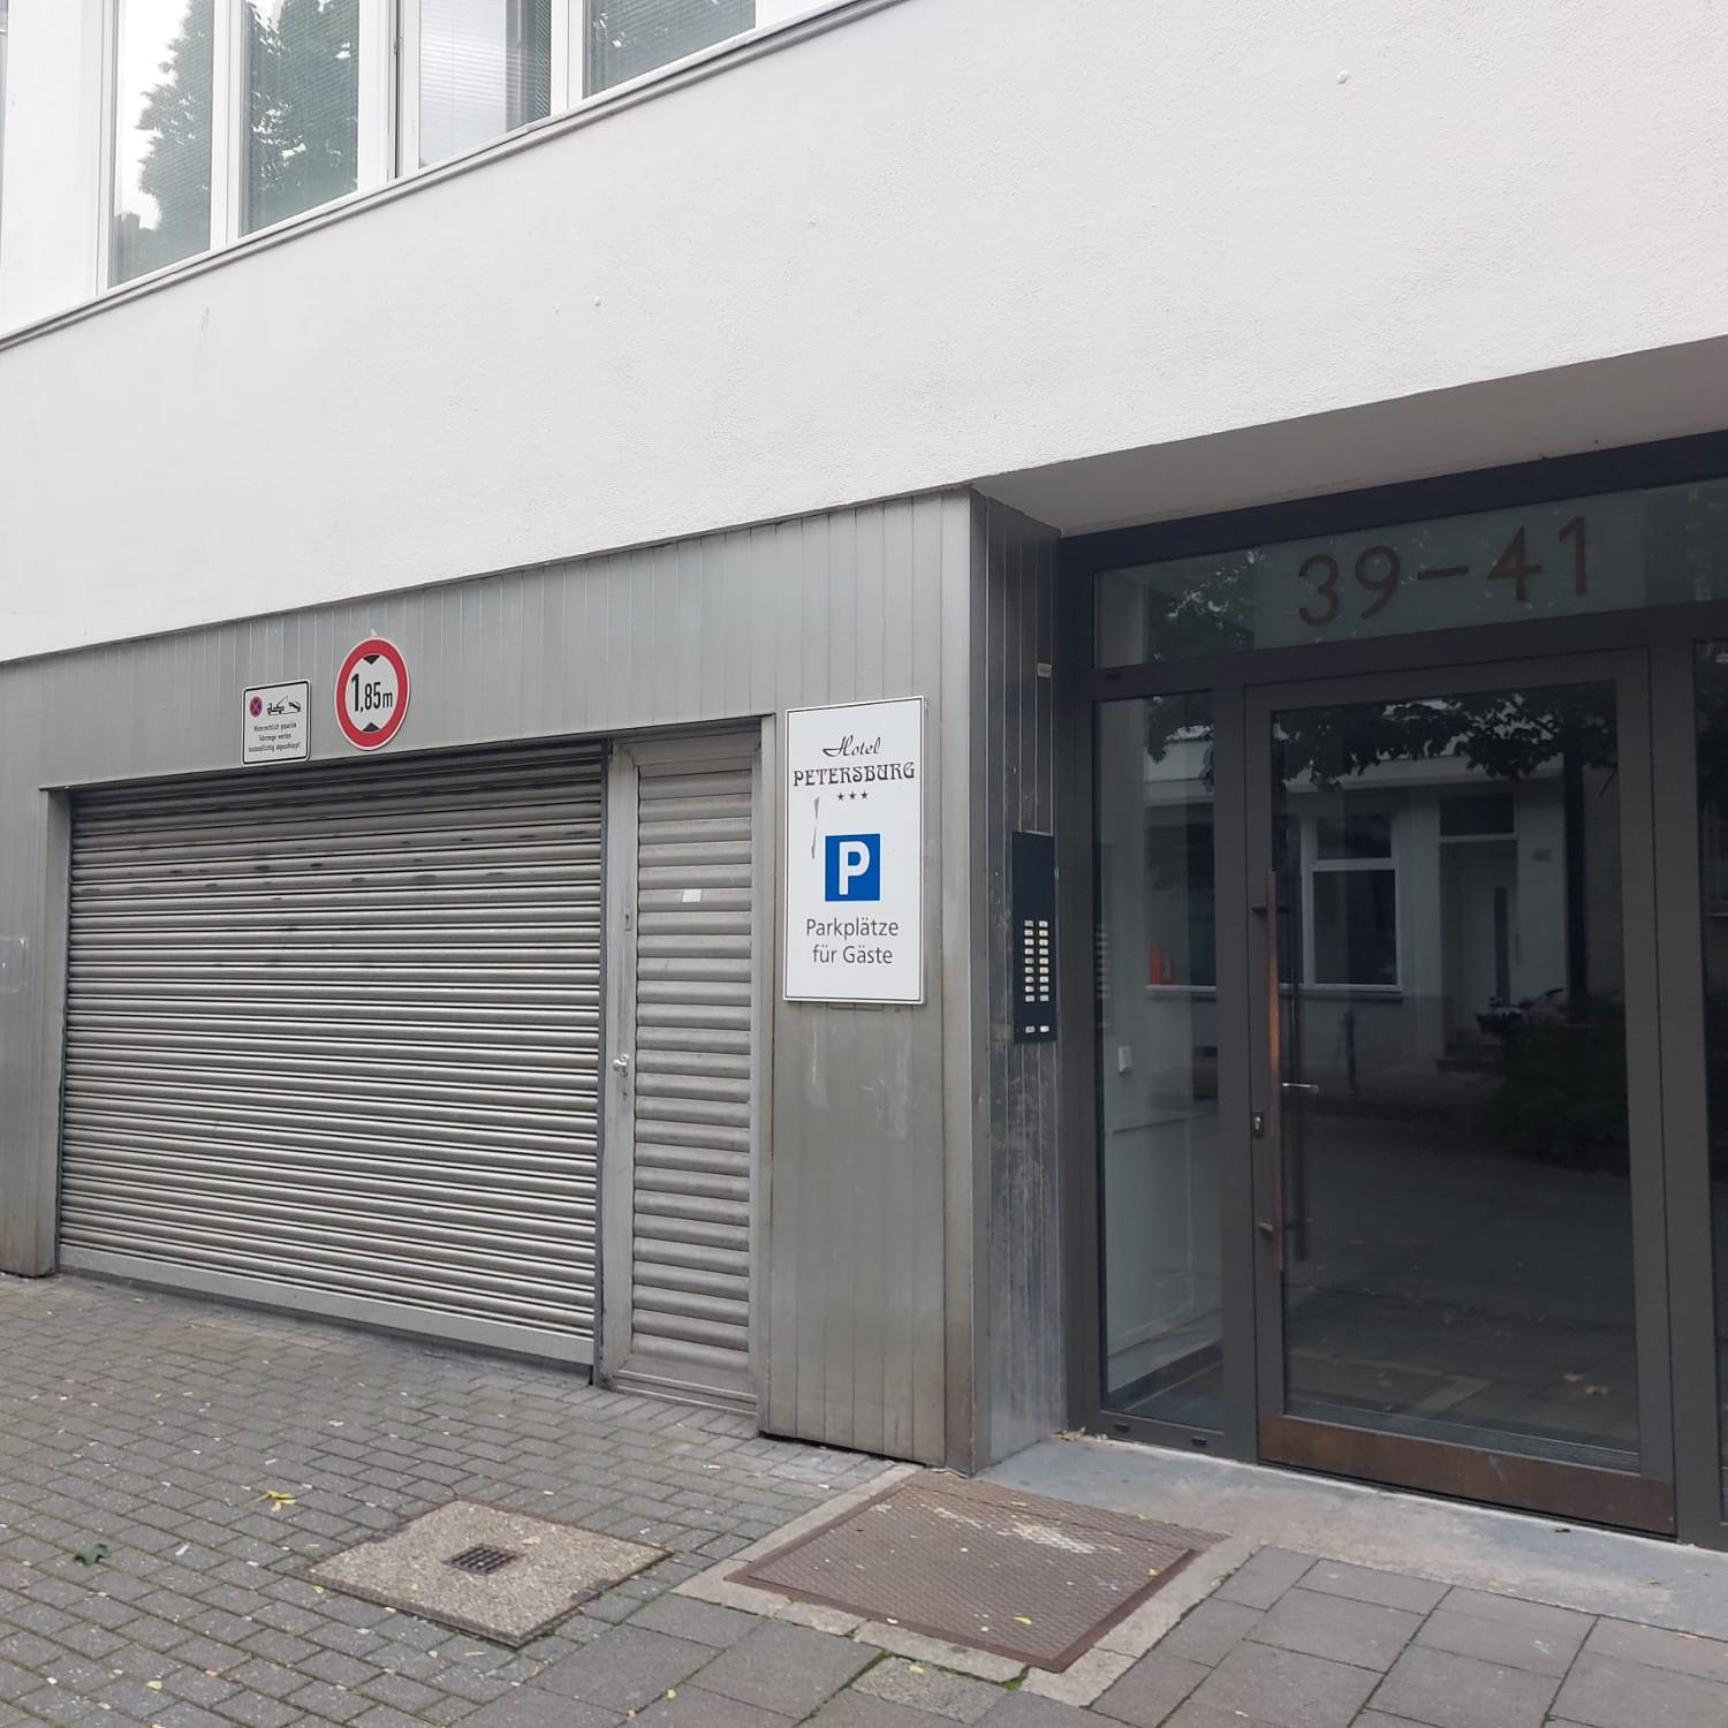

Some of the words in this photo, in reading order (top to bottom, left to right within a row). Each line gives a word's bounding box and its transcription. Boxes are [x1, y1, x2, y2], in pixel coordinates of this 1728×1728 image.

[822, 735, 880, 758] Hotel
[793, 761, 915, 787] PETERSBURG
[838, 840, 870, 896] P
[806, 917, 899, 940] Parkplätze
[813, 945, 837, 964] für
[842, 946, 893, 965] Gäste
